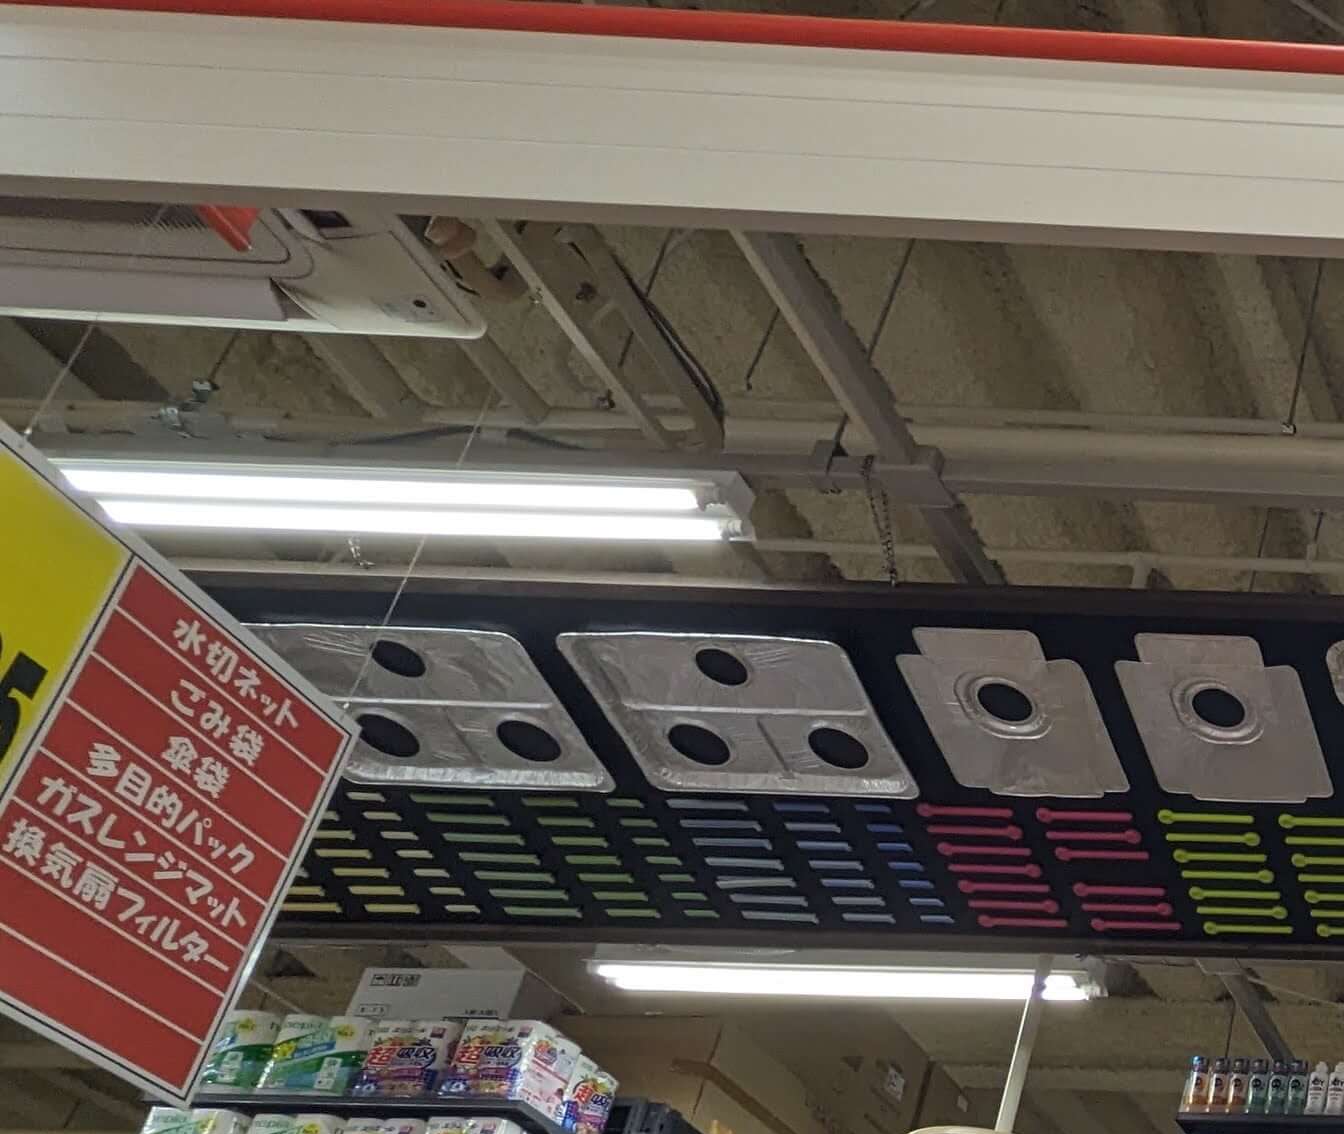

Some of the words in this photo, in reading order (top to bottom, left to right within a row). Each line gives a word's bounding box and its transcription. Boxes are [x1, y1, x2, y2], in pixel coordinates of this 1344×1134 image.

[169, 680, 265, 769] ごみ袋
[172, 618, 298, 732] 水切ネット
[87, 743, 256, 875] 多目的パック
[161, 736, 231, 800] 傘袋
[3, 817, 231, 974] 換気扇フィルター
[42, 777, 248, 929] ガスレンジマット
